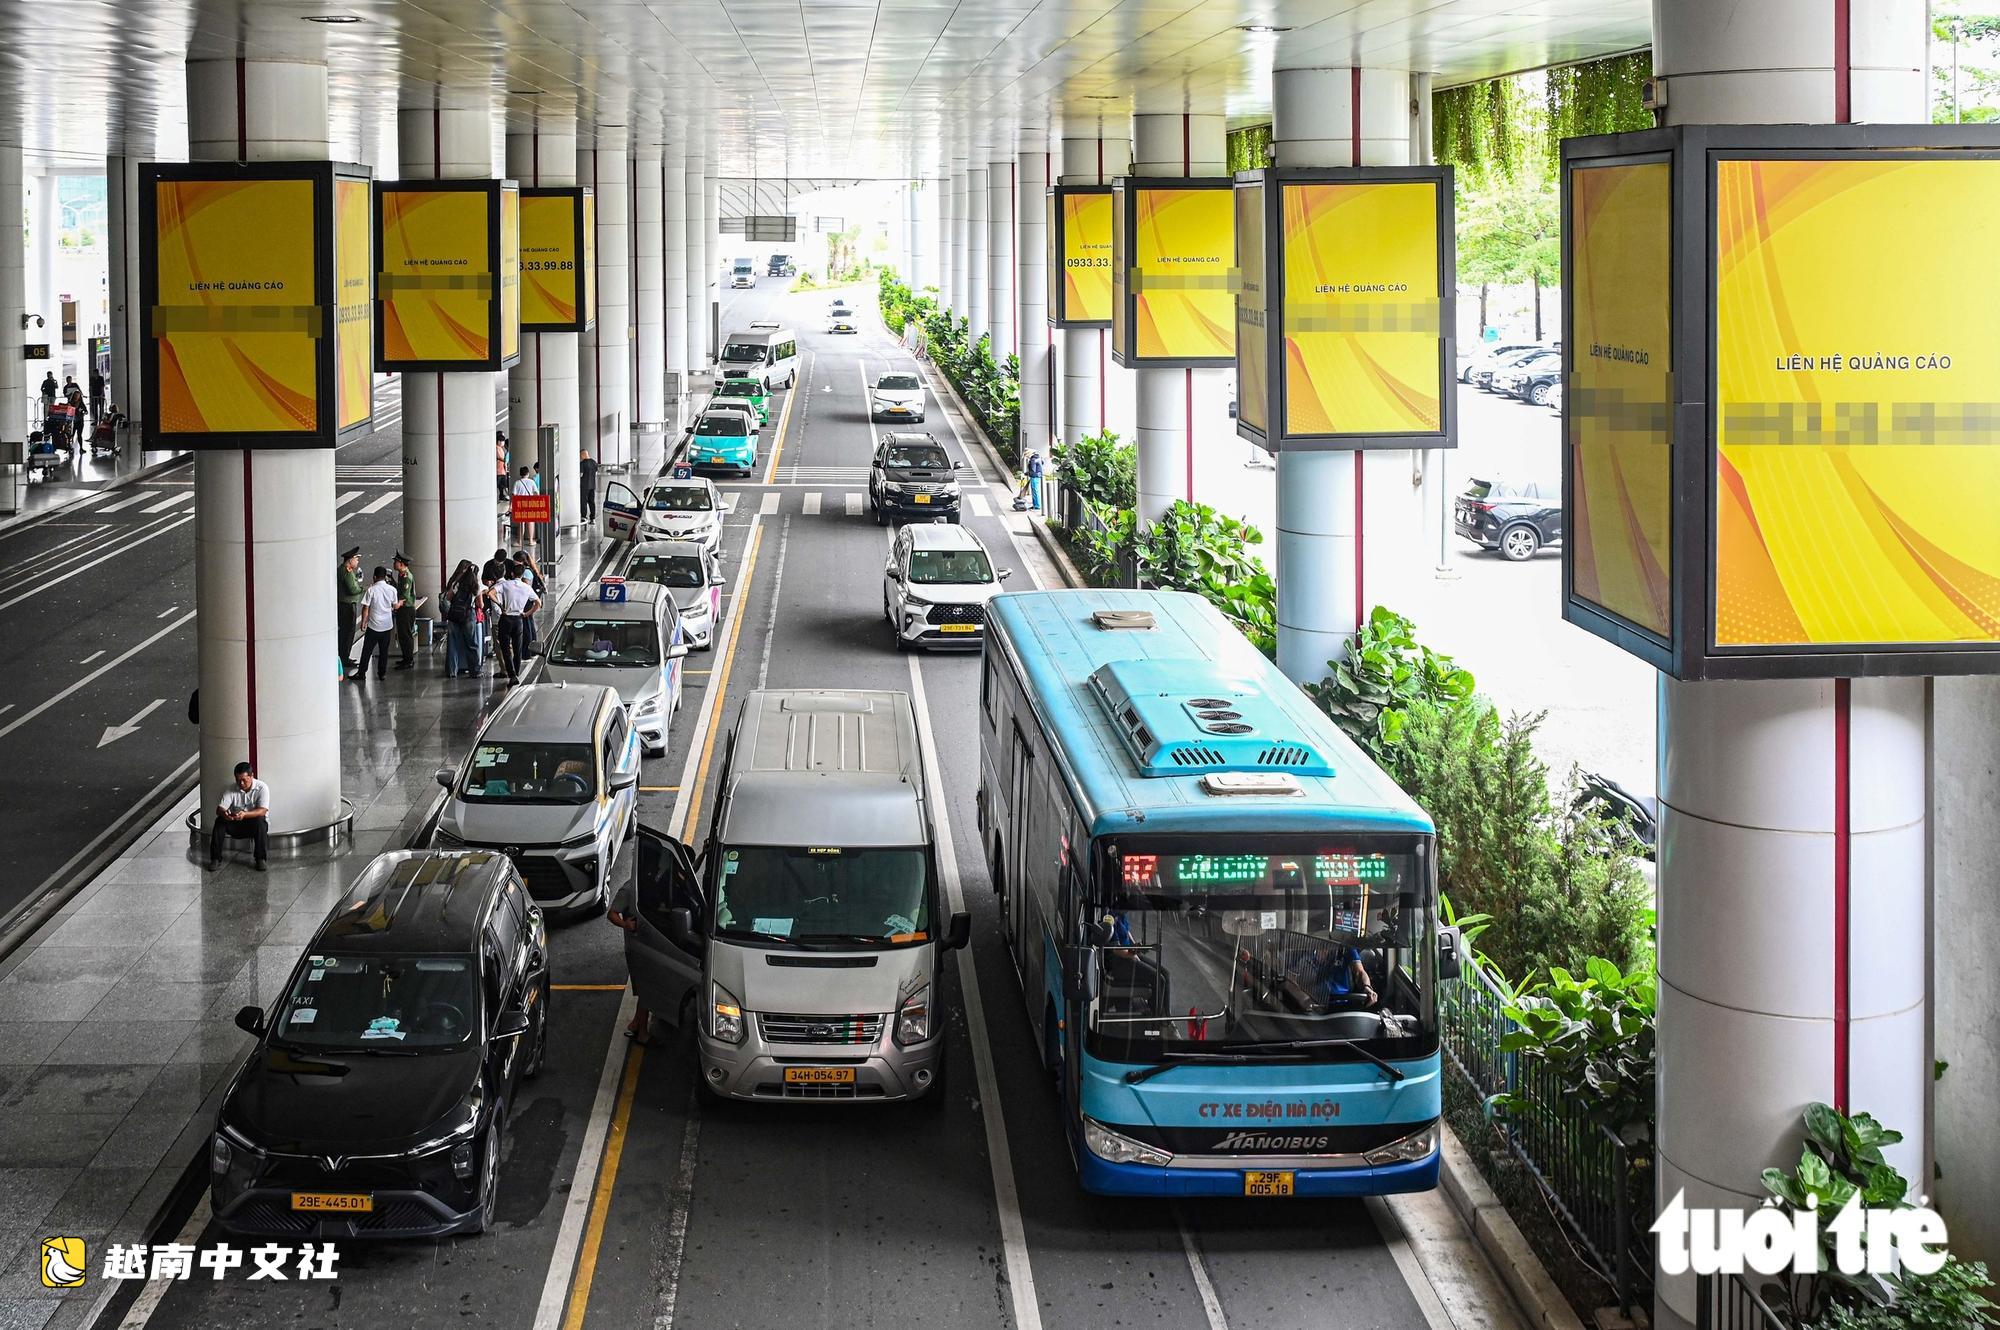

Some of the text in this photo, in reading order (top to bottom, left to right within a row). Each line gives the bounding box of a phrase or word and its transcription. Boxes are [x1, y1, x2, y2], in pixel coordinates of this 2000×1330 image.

[189, 280, 284, 291] LIÊN HỆ QUẢNG CÁO
[1315, 282, 1407, 293] LIÊN HỆ QUẢNG CÁO
[34, 348, 46, 356] 05
[1590, 342, 1648, 365] LIÊN HỆ QUẢNG CÁO
[1776, 352, 1951, 372] LIÊN HỆ QUẢNG CÁO
[606, 587, 620, 600] G7
[1199, 1099, 1340, 1122] CT XE ĐIỆN HÀ NỘI
[1250, 1184, 1288, 1194] 005.18
